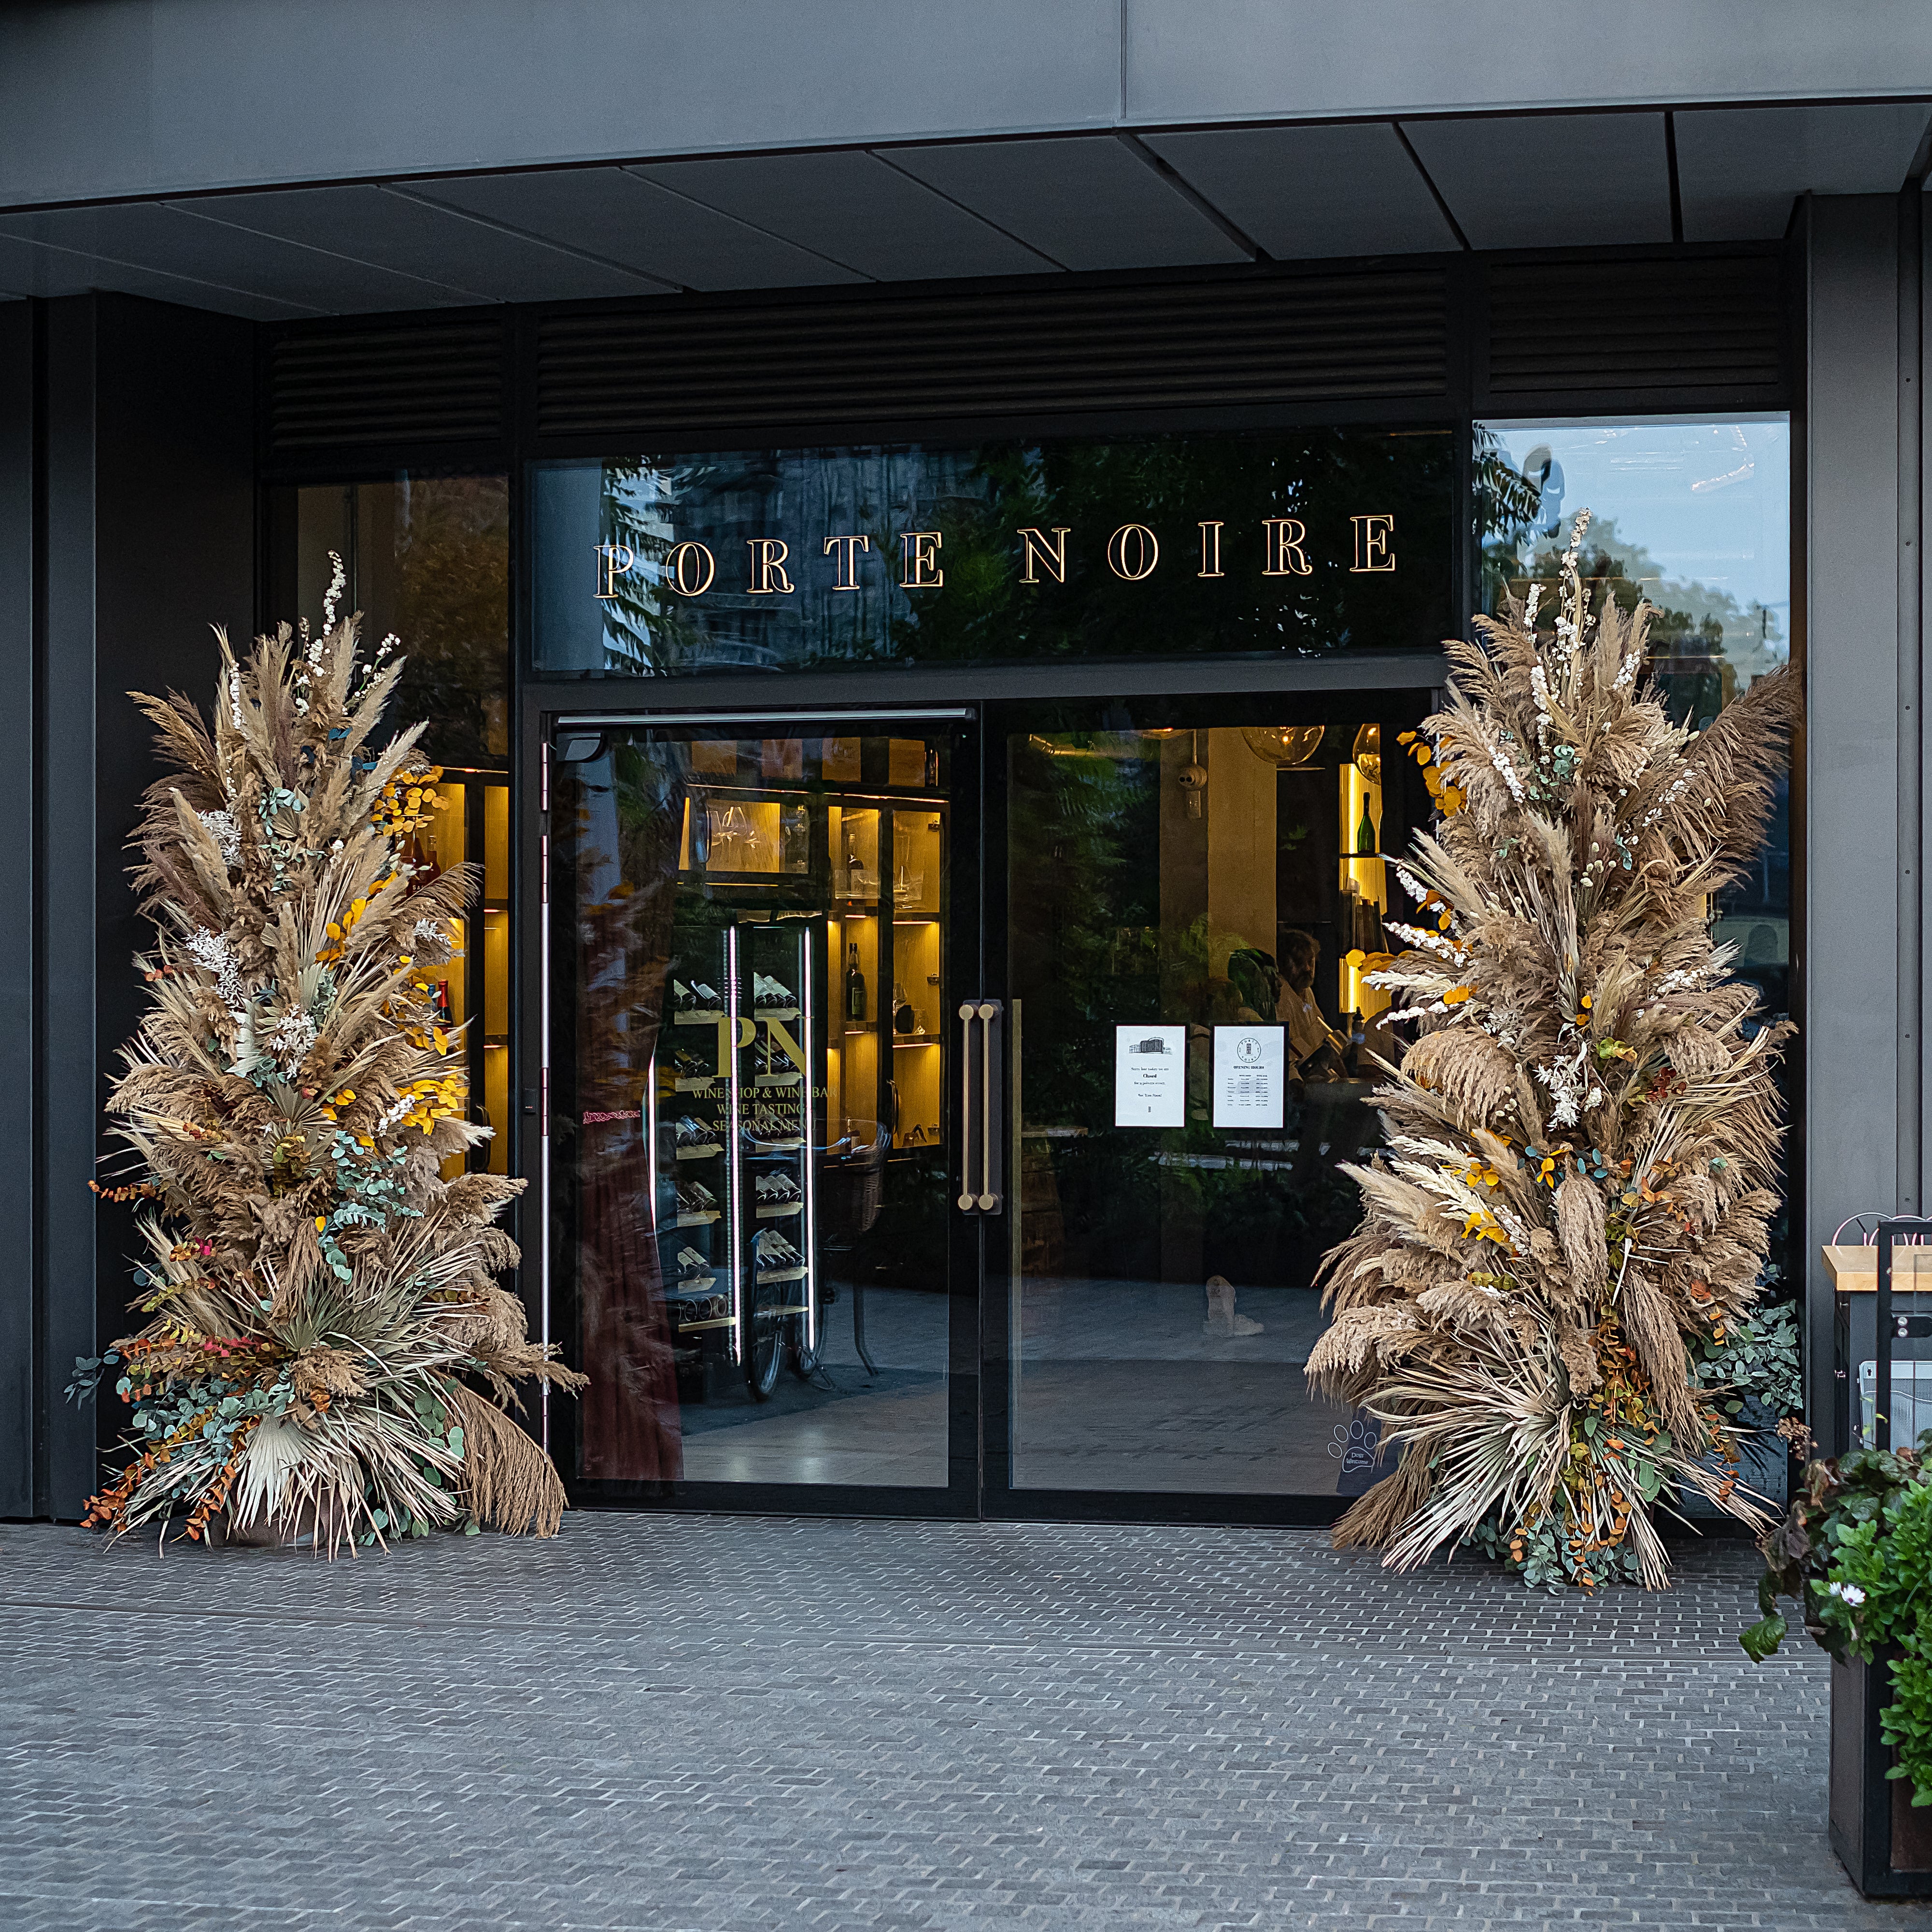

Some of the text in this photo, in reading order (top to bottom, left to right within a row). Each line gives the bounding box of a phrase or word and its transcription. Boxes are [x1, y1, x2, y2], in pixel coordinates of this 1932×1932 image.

[593, 514, 1396, 598] PORTE NOIRE
[712, 1016, 815, 1078] PN
[692, 1087, 725, 1099] WINE
[762, 1087, 772, 1098] &
[812, 1087, 838, 1098] BAR
[717, 1103, 805, 1115] WINE TASTING
